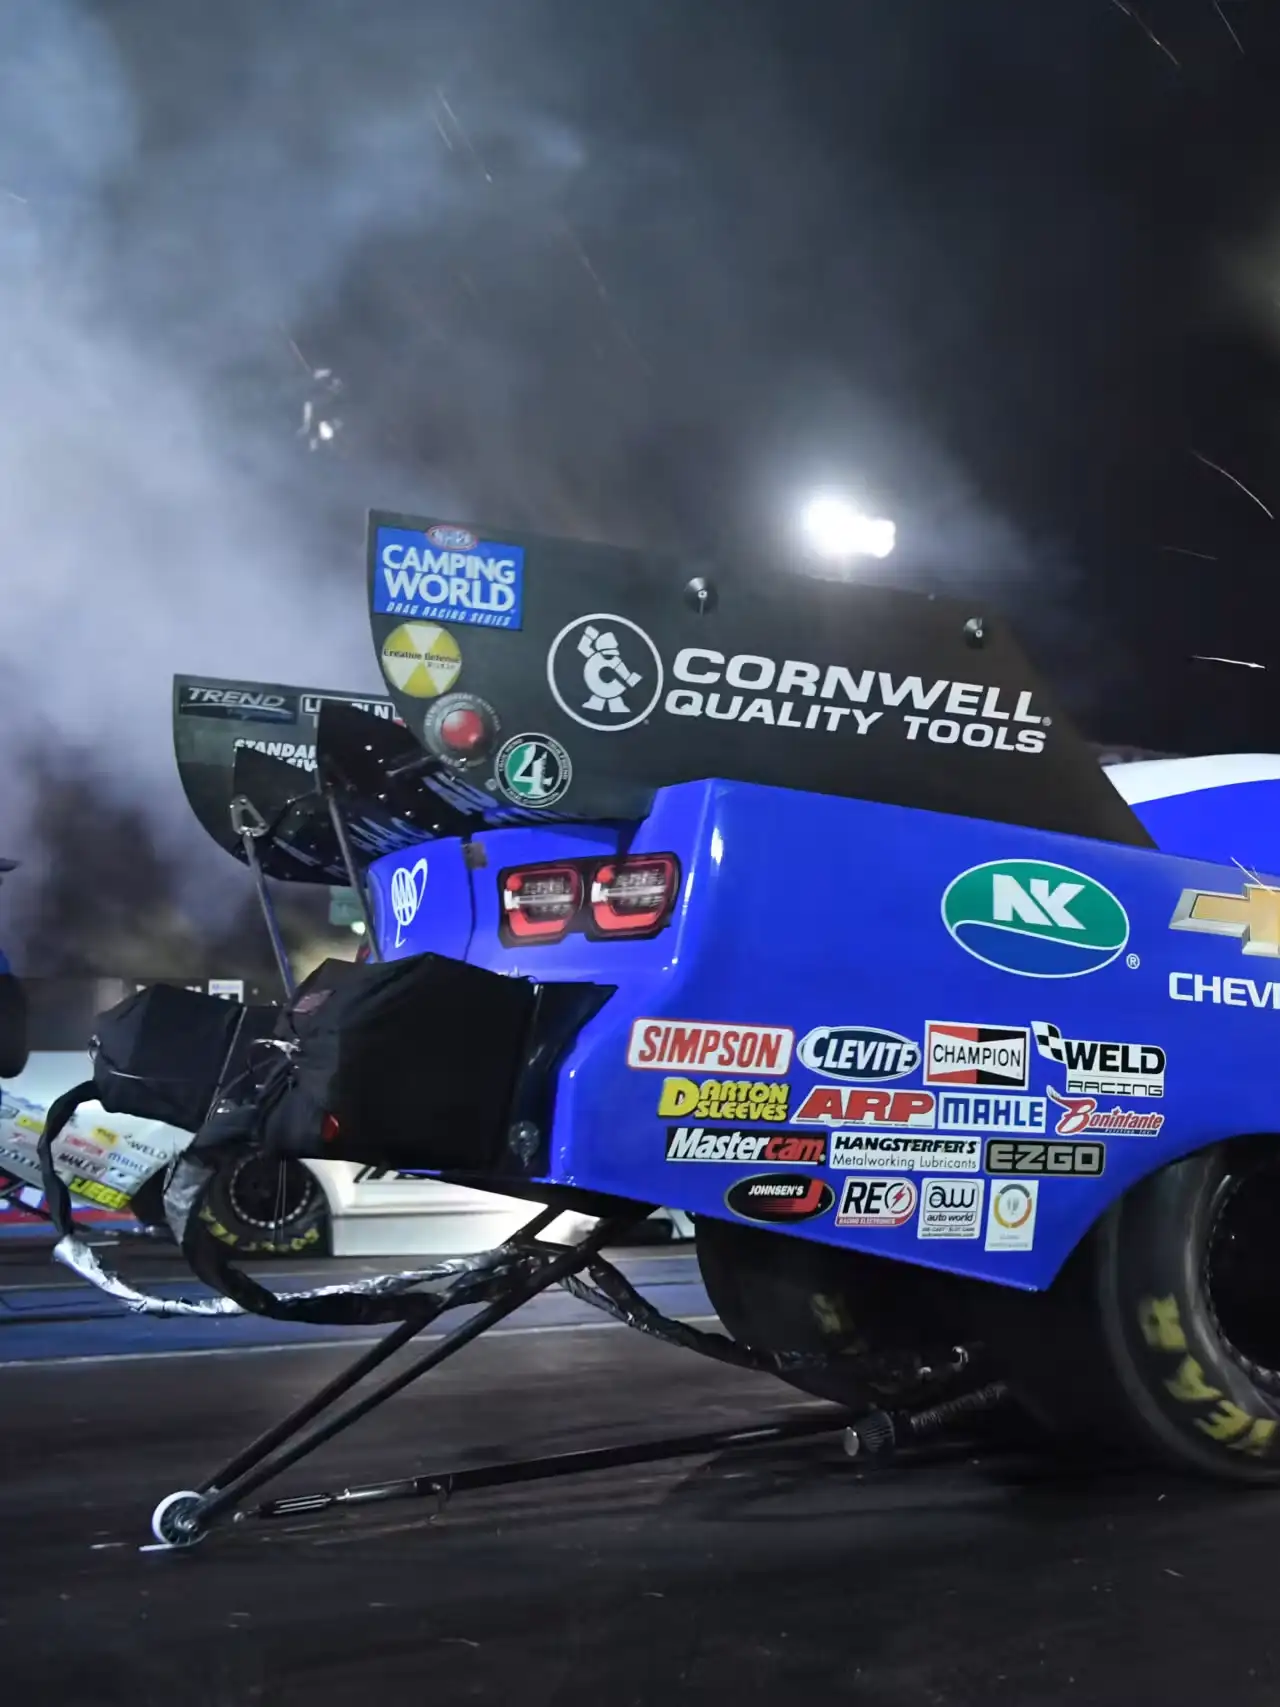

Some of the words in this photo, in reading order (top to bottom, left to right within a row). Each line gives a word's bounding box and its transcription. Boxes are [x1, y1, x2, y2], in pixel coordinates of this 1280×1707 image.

[382, 544, 516, 584] CAMPING
[383, 567, 516, 612] WORLD
[386, 601, 420, 615] DRAG
[422, 606, 467, 621] RACING
[470, 612, 512, 627] SERIES
[188, 687, 285, 708] TREND
[672, 647, 1042, 725] CORNWELL
[664, 689, 883, 735] QUALITY
[902, 715, 1047, 754] TOOLS
[234, 738, 317, 760] STANDA
[512, 744, 554, 795] 4
[992, 873, 1087, 930] NK
[638, 1025, 783, 1069] SIMPSON
[803, 1027, 918, 1073] CLEVITE
[933, 1044, 1022, 1068] CHAMPION
[1064, 1041, 1166, 1075] WELD
[657, 1076, 790, 1117] DARTON
[1067, 1080, 1163, 1097] RACING
[695, 1101, 788, 1122] SLEEVES
[797, 1088, 934, 1122] ARP
[942, 1097, 1043, 1127] MAHLE
[130, 1142, 168, 1161] WELD
[667, 1128, 822, 1161] Mastercam
[835, 1136, 977, 1154] HANGSTERFER'S
[989, 1143, 1097, 1173] EZGO
[832, 1153, 915, 1171] Metalworking
[920, 1154, 977, 1170] Lubricants
[748, 1184, 803, 1196] JOHNSEN'S
[927, 1214, 947, 1222] auto
[948, 1213, 973, 1222] world
